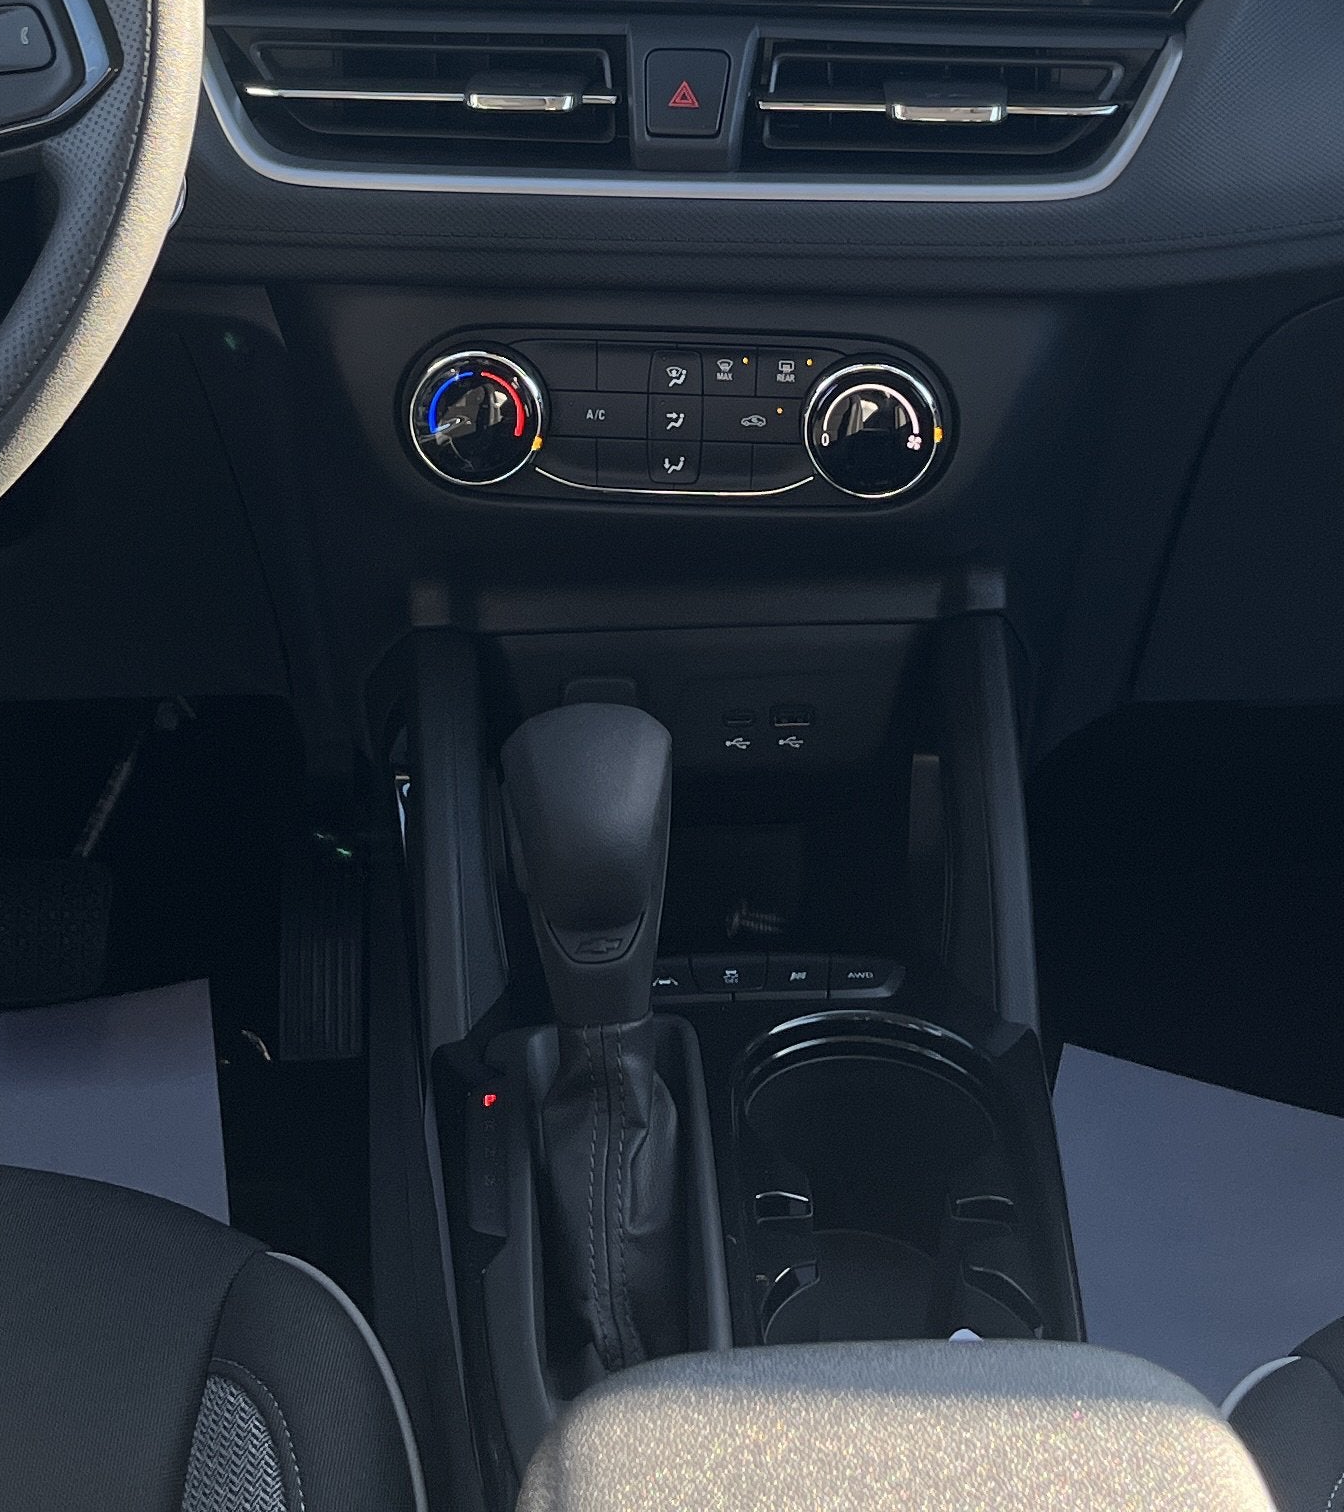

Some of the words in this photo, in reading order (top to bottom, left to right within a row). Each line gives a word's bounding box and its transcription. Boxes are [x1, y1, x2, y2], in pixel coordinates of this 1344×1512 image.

[716, 371, 734, 382] MAX
[776, 373, 796, 384] REAR
[586, 409, 606, 421] A/C
[847, 971, 874, 979] AWD
[483, 1092, 497, 1107] P
